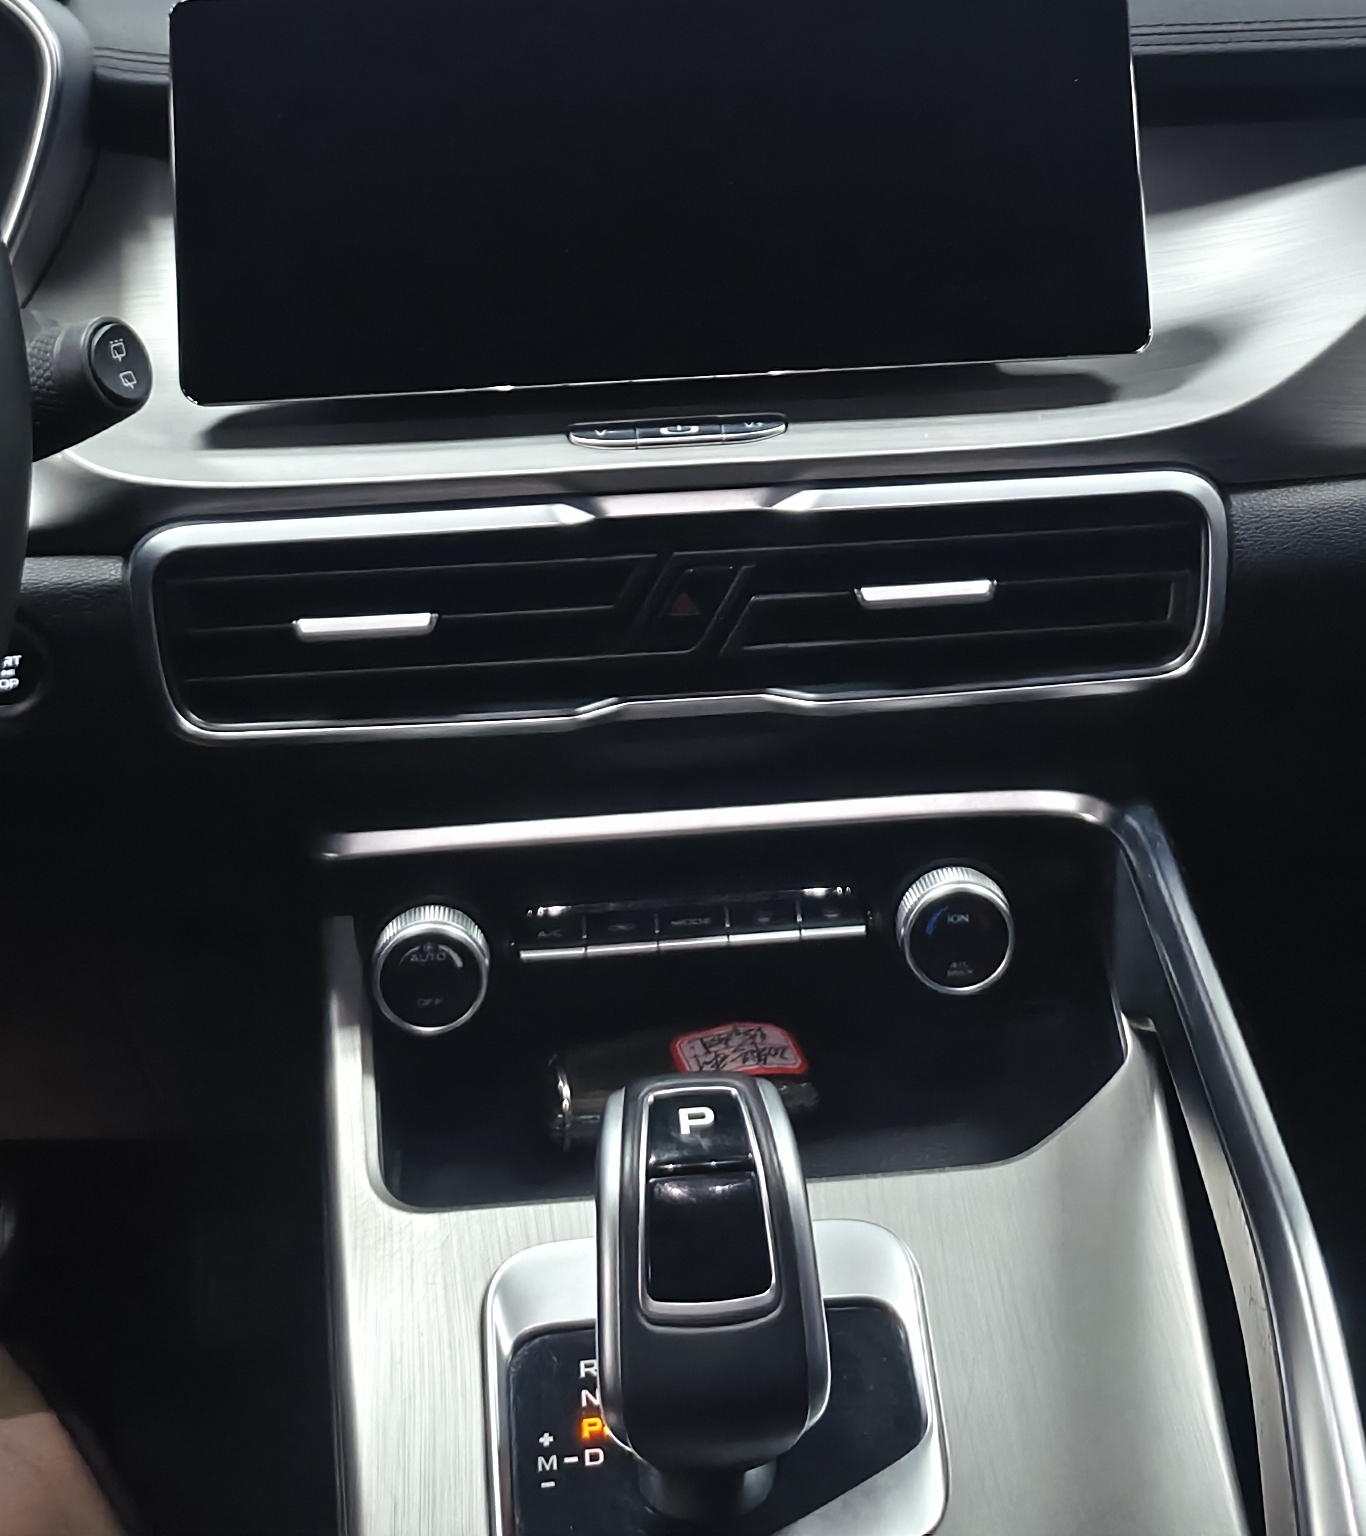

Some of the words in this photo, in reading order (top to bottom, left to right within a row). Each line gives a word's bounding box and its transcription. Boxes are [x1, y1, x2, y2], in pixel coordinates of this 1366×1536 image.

[409, 952, 448, 963] AUTO
[678, 1106, 715, 1135] P
[580, 1358, 598, 1378] R
[581, 1388, 602, 1407] N
[581, 1417, 603, 1439] P
